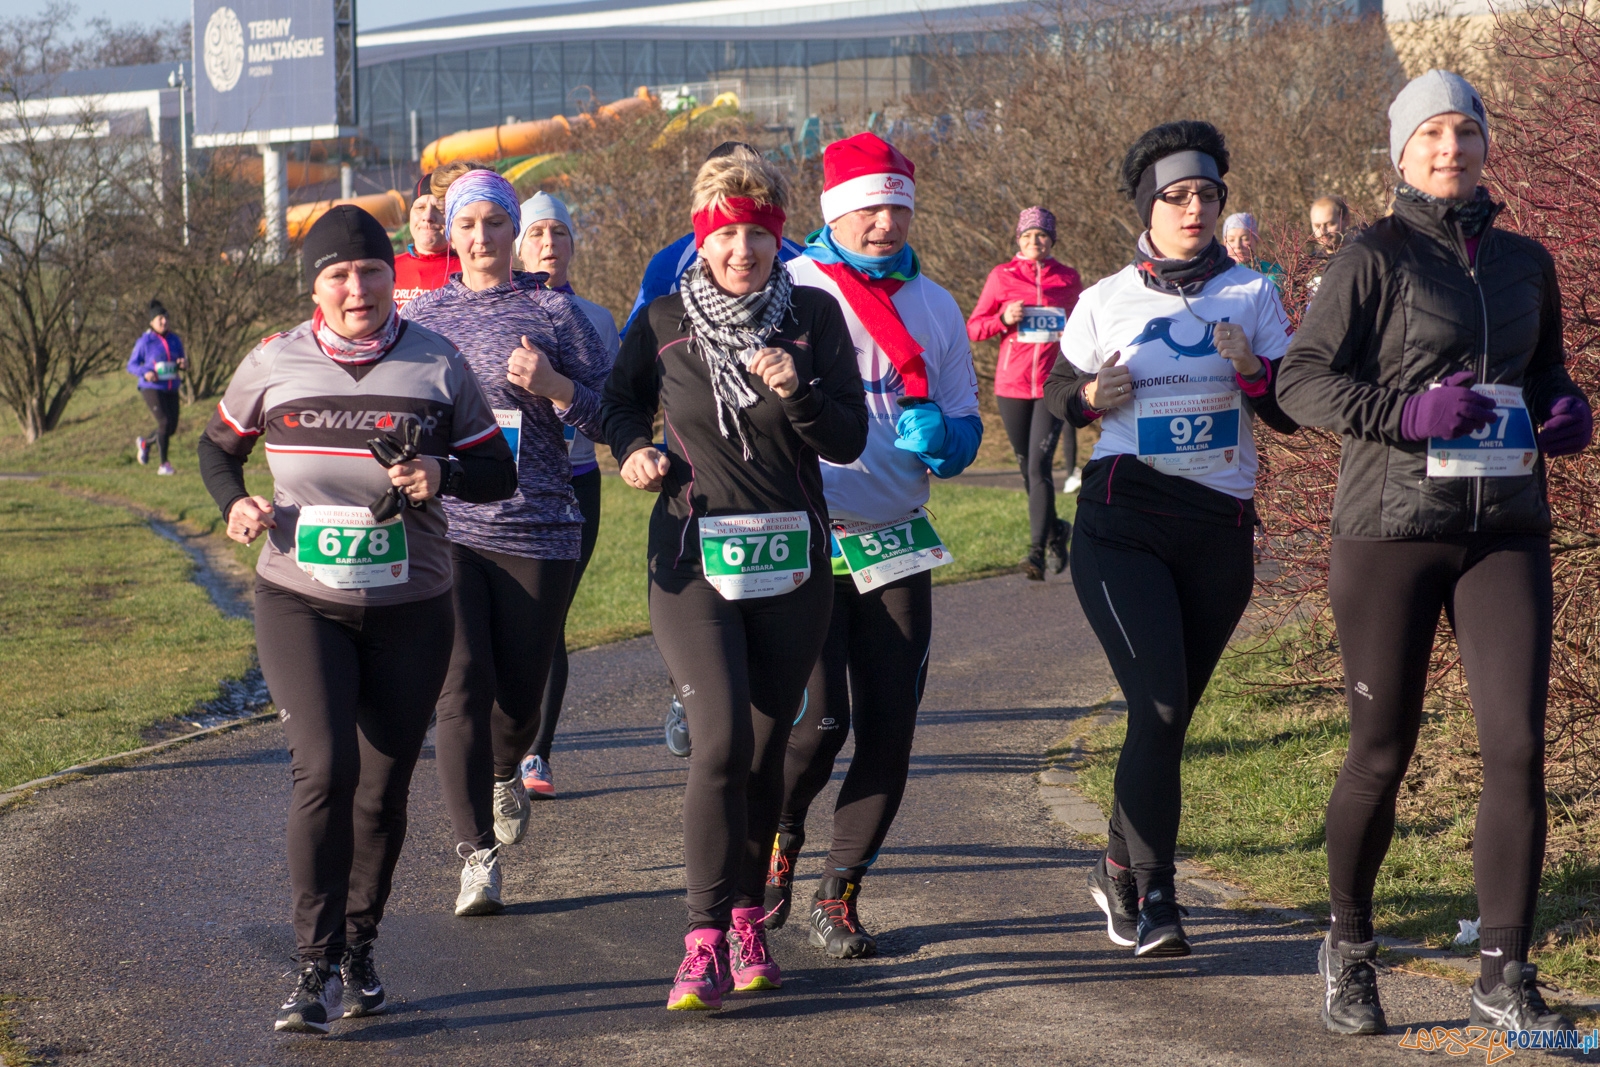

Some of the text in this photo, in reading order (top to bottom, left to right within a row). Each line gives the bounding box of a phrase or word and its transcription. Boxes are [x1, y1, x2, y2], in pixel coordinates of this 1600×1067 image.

[248, 18, 291, 40] TERMY
[248, 35, 324, 63] MALTAŃSKIE
[1027, 316, 1058, 329] 103
[1131, 374, 1189, 390] WRONIECKI
[1209, 375, 1237, 383] BIEGACZ
[1170, 399, 1187, 407] BIEG
[1188, 395, 1234, 405] SYLWESTROWY
[1169, 415, 1214, 445] 92
[1176, 443, 1209, 452] MARLENA
[1479, 440, 1504, 448] ANETA
[327, 518, 365, 526] RYSZARDA
[734, 518, 751, 526] BIEG
[752, 515, 803, 525] SYLWESTROWY
[729, 526, 766, 534] RYSZARDA
[318, 528, 390, 557] 678
[859, 522, 915, 556] 557
[722, 534, 790, 567] 676
[881, 546, 914, 559] SŁAWOMIR
[741, 564, 774, 573] BARBARA
